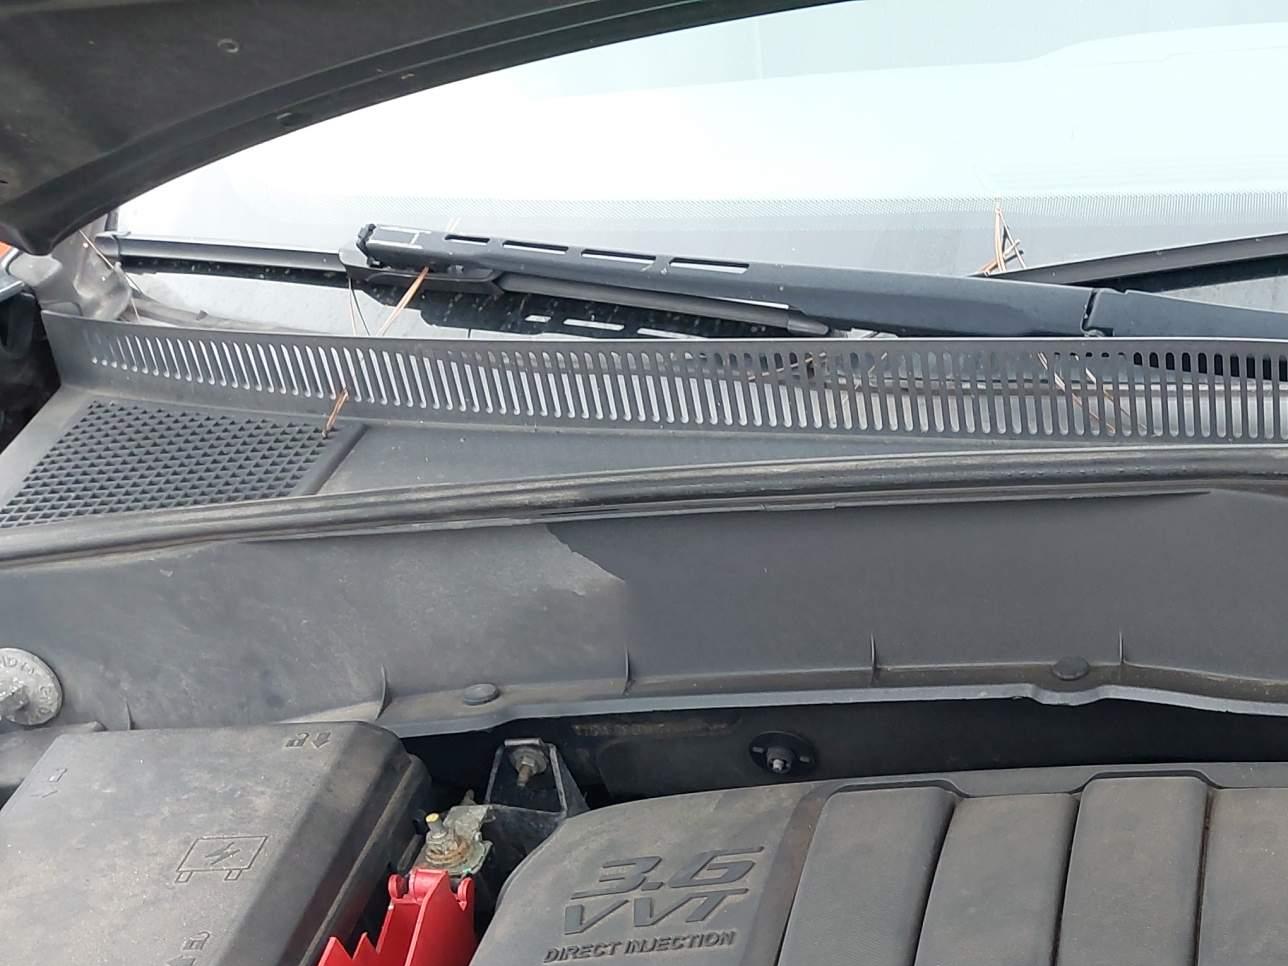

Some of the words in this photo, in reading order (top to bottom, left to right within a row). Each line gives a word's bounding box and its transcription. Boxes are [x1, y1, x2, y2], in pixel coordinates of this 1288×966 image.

[570, 846, 765, 900] 3.6
[564, 887, 750, 936] VVT
[543, 940, 623, 964] DIRECT
[624, 930, 738, 955] INJECTION
